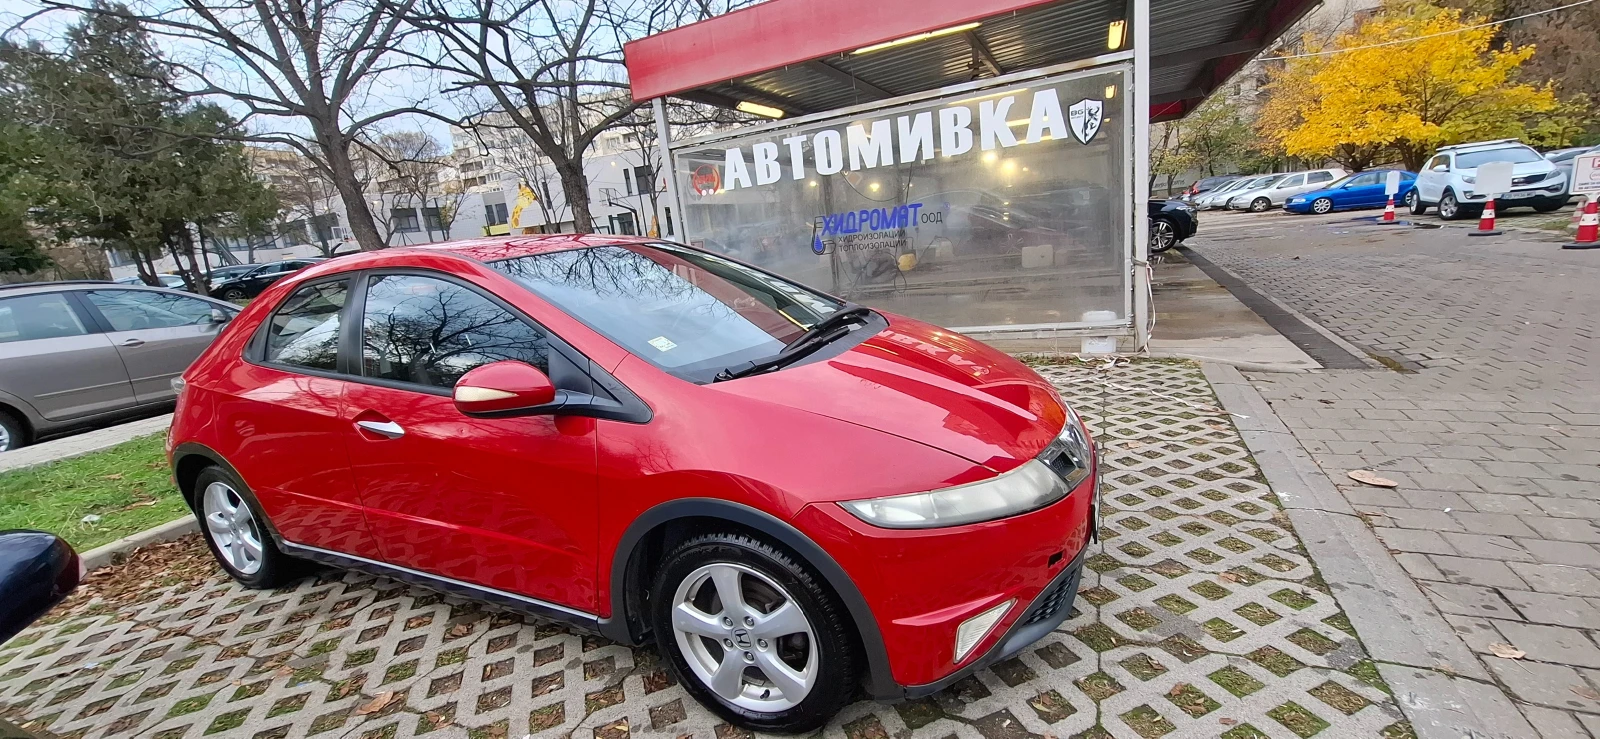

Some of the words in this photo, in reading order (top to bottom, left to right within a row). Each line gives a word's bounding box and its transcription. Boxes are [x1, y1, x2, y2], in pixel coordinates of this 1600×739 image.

[724, 88, 1068, 190] АВТОМИВКА
[821, 203, 923, 236] ХИДРОМАТ
[921, 212, 943, 224] ООД
[838, 230, 906, 243] ХИДРОИЗОЛАЦИИ
[838, 239, 907, 252] ТОПЛОИЗОЛАЦИИ
